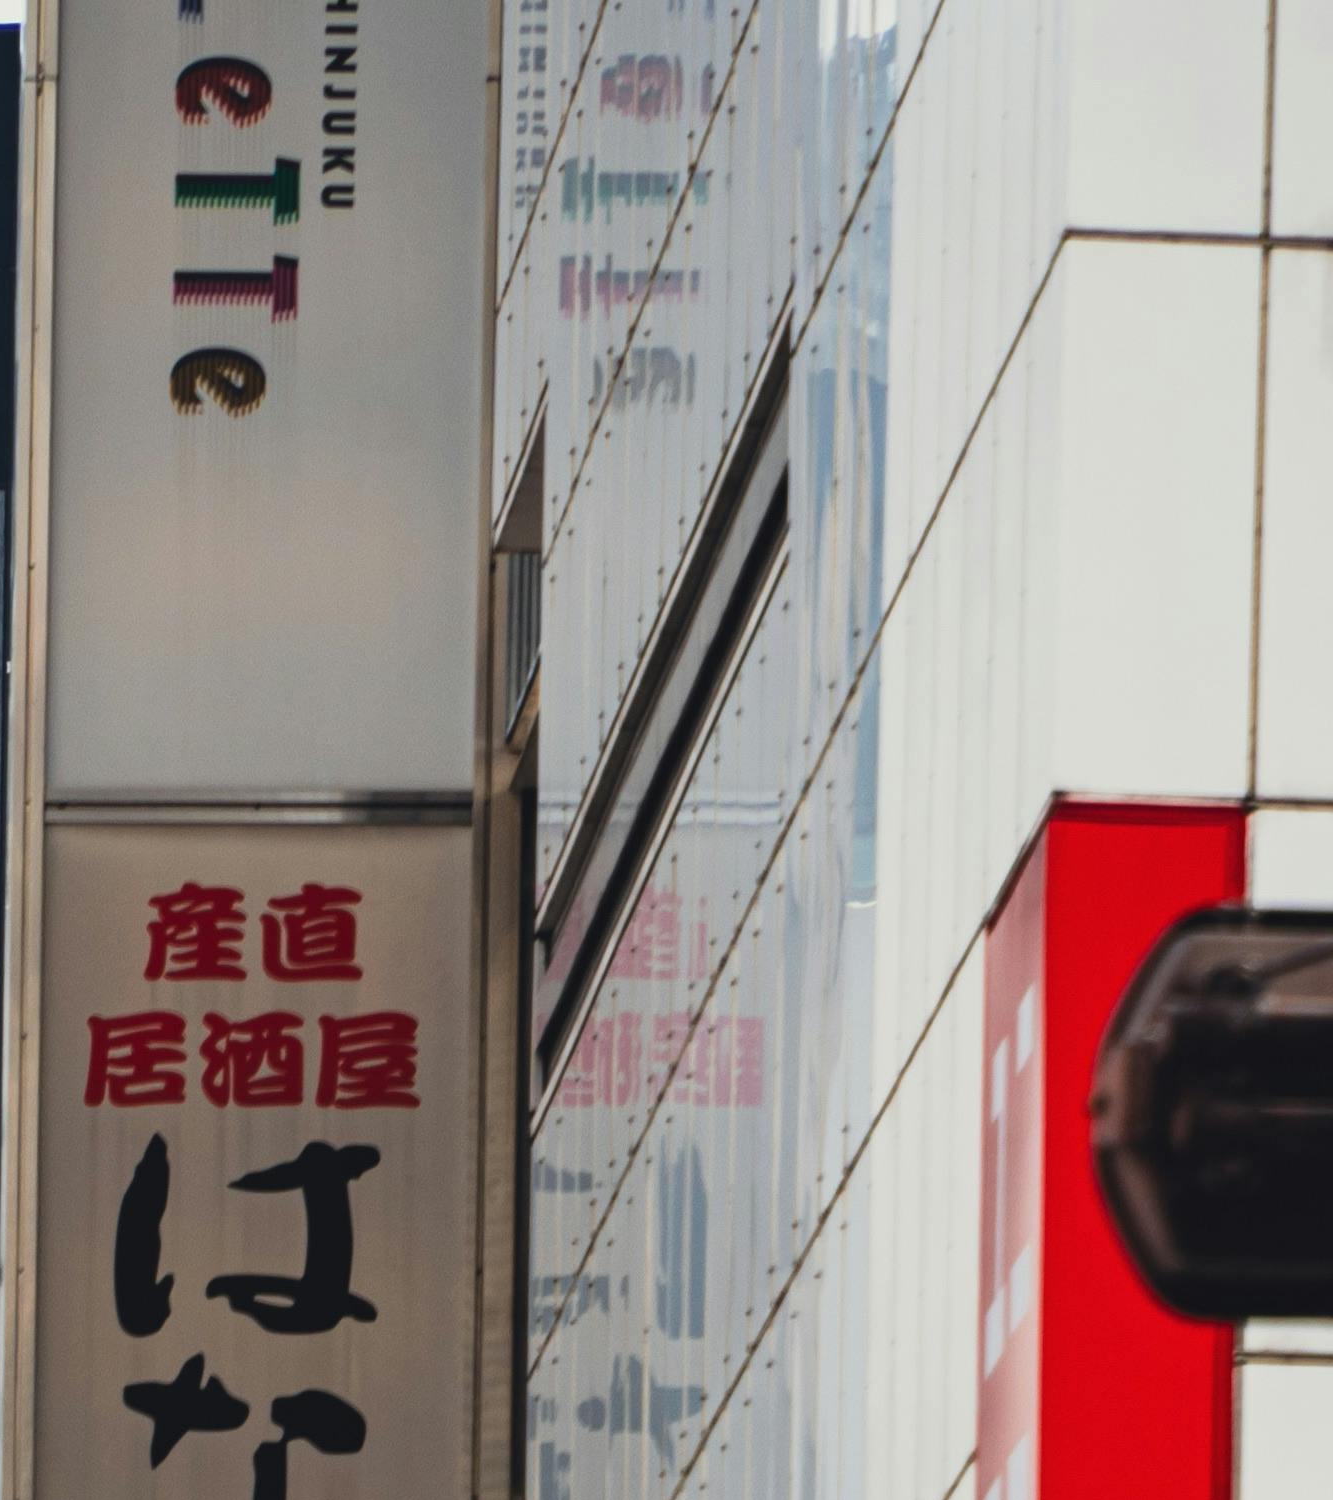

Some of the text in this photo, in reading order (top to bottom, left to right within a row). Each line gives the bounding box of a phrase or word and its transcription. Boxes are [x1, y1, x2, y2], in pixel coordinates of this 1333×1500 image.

[143, 882, 364, 982] 産直
[83, 1011, 420, 1108] 居酒屋
